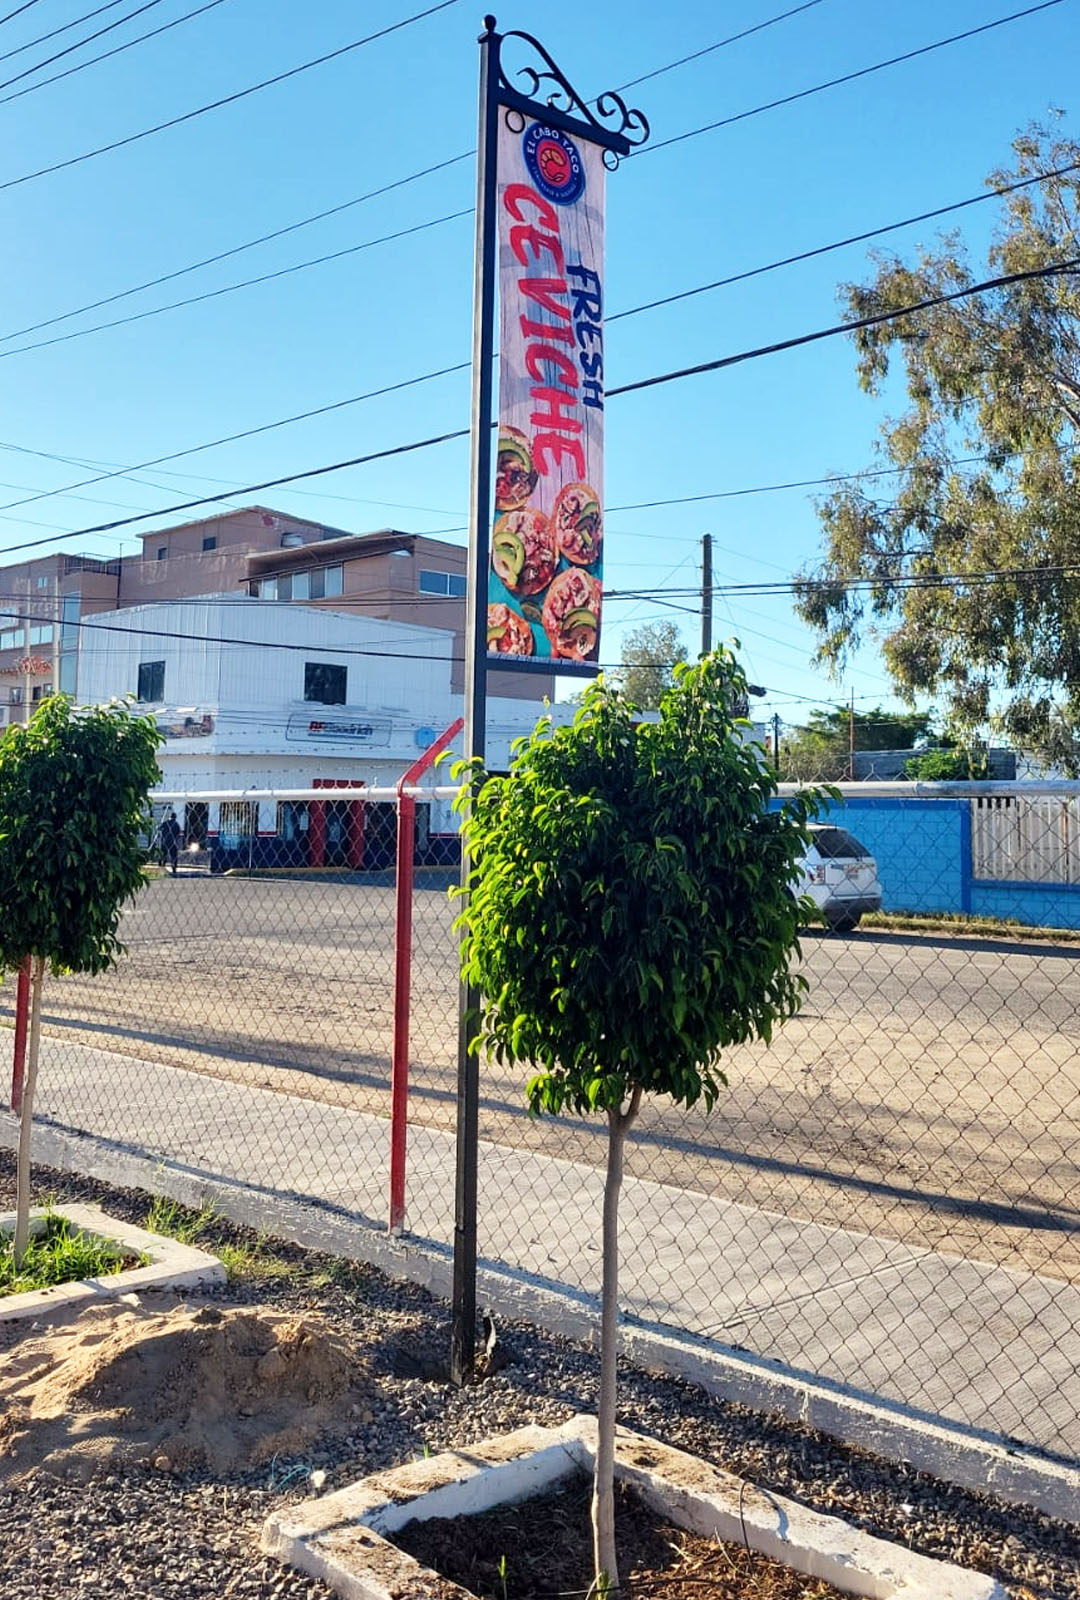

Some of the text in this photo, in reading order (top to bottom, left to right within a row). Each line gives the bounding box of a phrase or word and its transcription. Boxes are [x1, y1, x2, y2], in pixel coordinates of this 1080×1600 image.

[527, 127, 579, 173] EL CABO TACO
[503, 183, 586, 480] CEVICHE
[566, 264, 604, 411] FRESH
